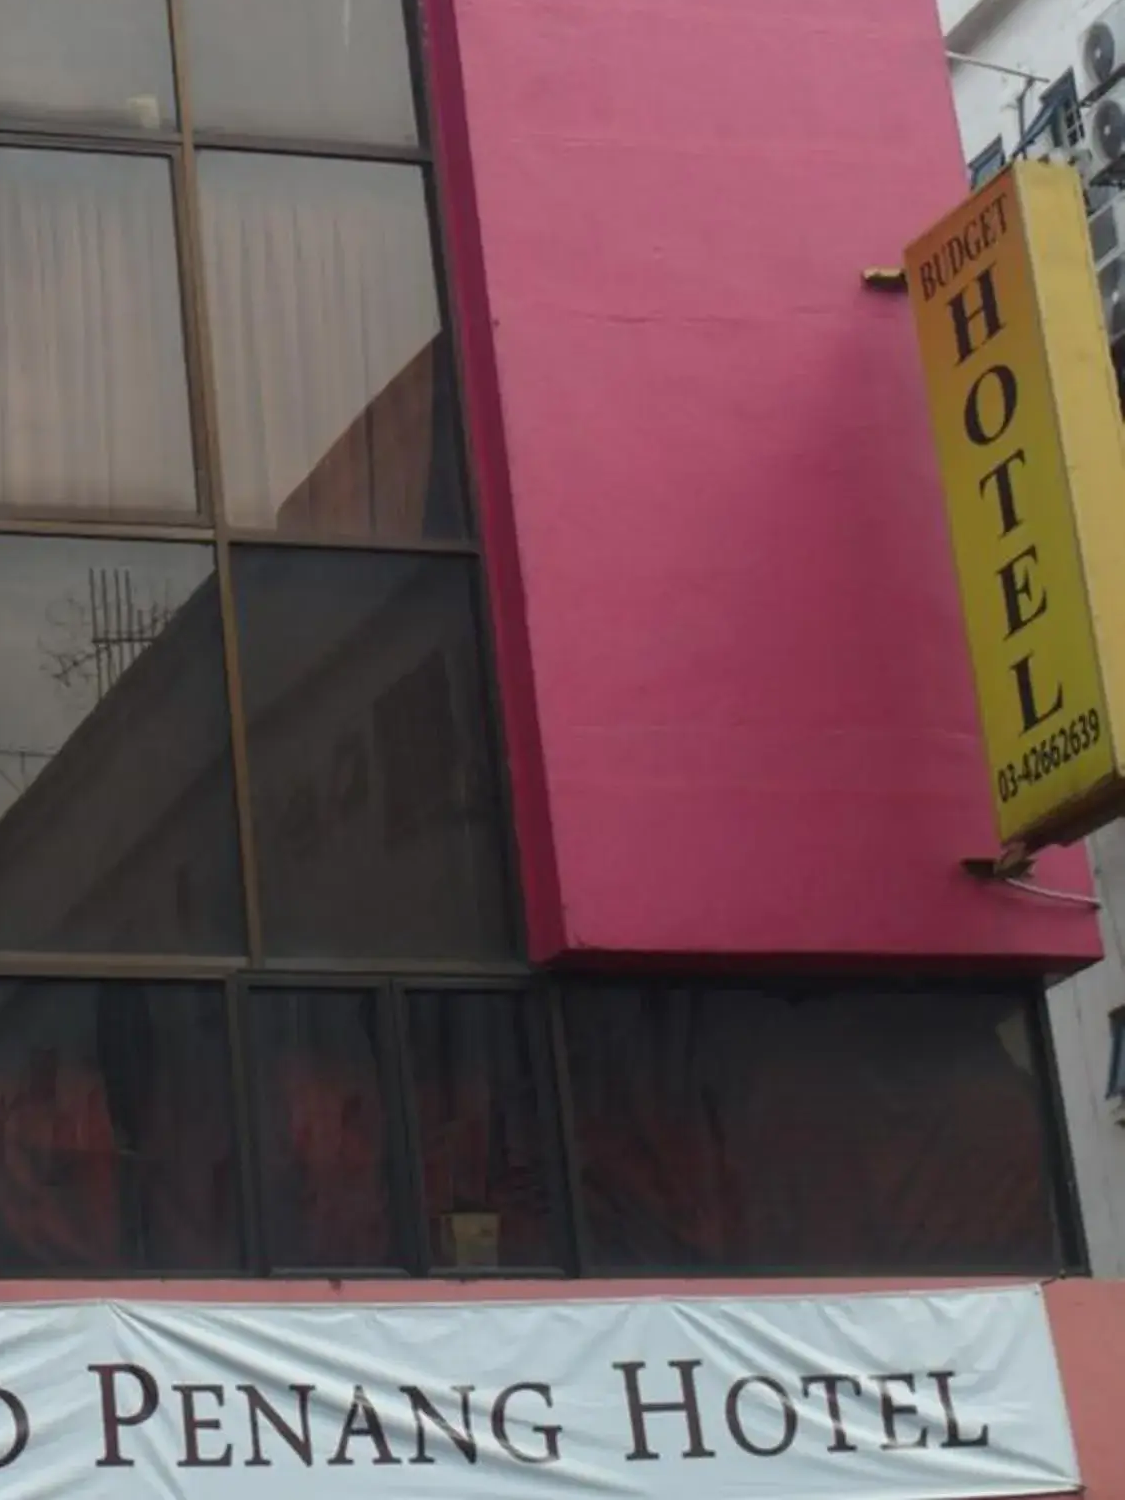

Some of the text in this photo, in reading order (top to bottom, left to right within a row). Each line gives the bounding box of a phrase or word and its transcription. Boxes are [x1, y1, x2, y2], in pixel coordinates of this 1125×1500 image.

[918, 193, 1009, 302] BUDGET
[945, 261, 1065, 738] HOTEL
[997, 707, 1101, 803] 03-42662639
[87, 1363, 565, 1468] PENANG
[611, 1358, 992, 1462] HOTEL
